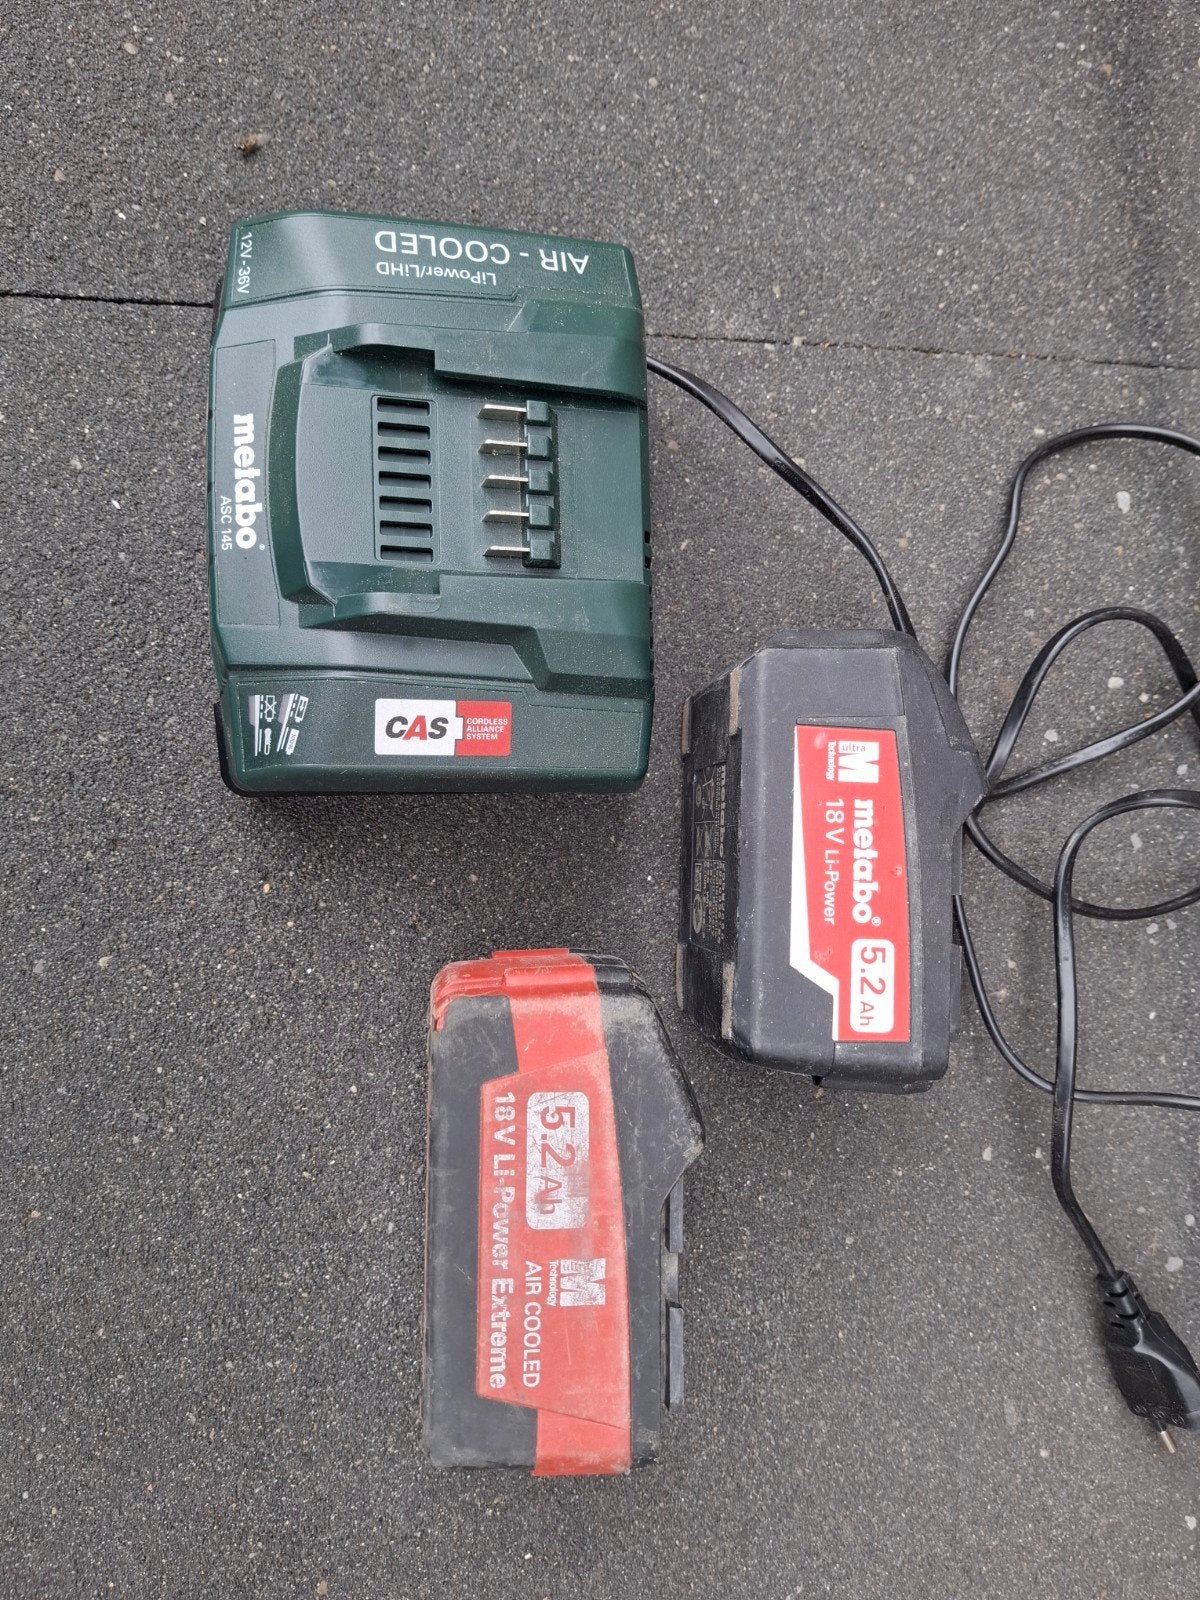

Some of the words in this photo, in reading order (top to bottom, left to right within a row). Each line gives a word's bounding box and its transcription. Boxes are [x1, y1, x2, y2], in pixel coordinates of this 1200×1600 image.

[240, 232, 253, 258] 12V
[374, 230, 511, 265] COOLED
[376, 261, 497, 286] LiPower/LiHD
[539, 249, 589, 275] AIR
[237, 266, 251, 294] 36V
[220, 495, 232, 524] ASC
[221, 530, 233, 551] 145
[385, 715, 449, 741] CAS
[466, 717, 508, 725] CORDLESS
[466, 725, 504, 733] ALLIANCE
[825, 740, 837, 781] Technology
[825, 798, 845, 823] 18
[825, 827, 845, 845] V
[823, 849, 840, 926] Li-Power
[860, 946, 886, 995] 5.2
[860, 1000, 875, 1026] Ah
[494, 1092, 516, 1121] 18
[493, 1125, 516, 1146] V
[540, 1106, 576, 1168] 5.2
[537, 1176, 563, 1215] Ah
[492, 1154, 516, 1270] Li-Power
[525, 1261, 543, 1295] AIR
[547, 1260, 559, 1307] Technology
[489, 1278, 515, 1389] Extreme
[523, 1302, 542, 1388] COOLED
